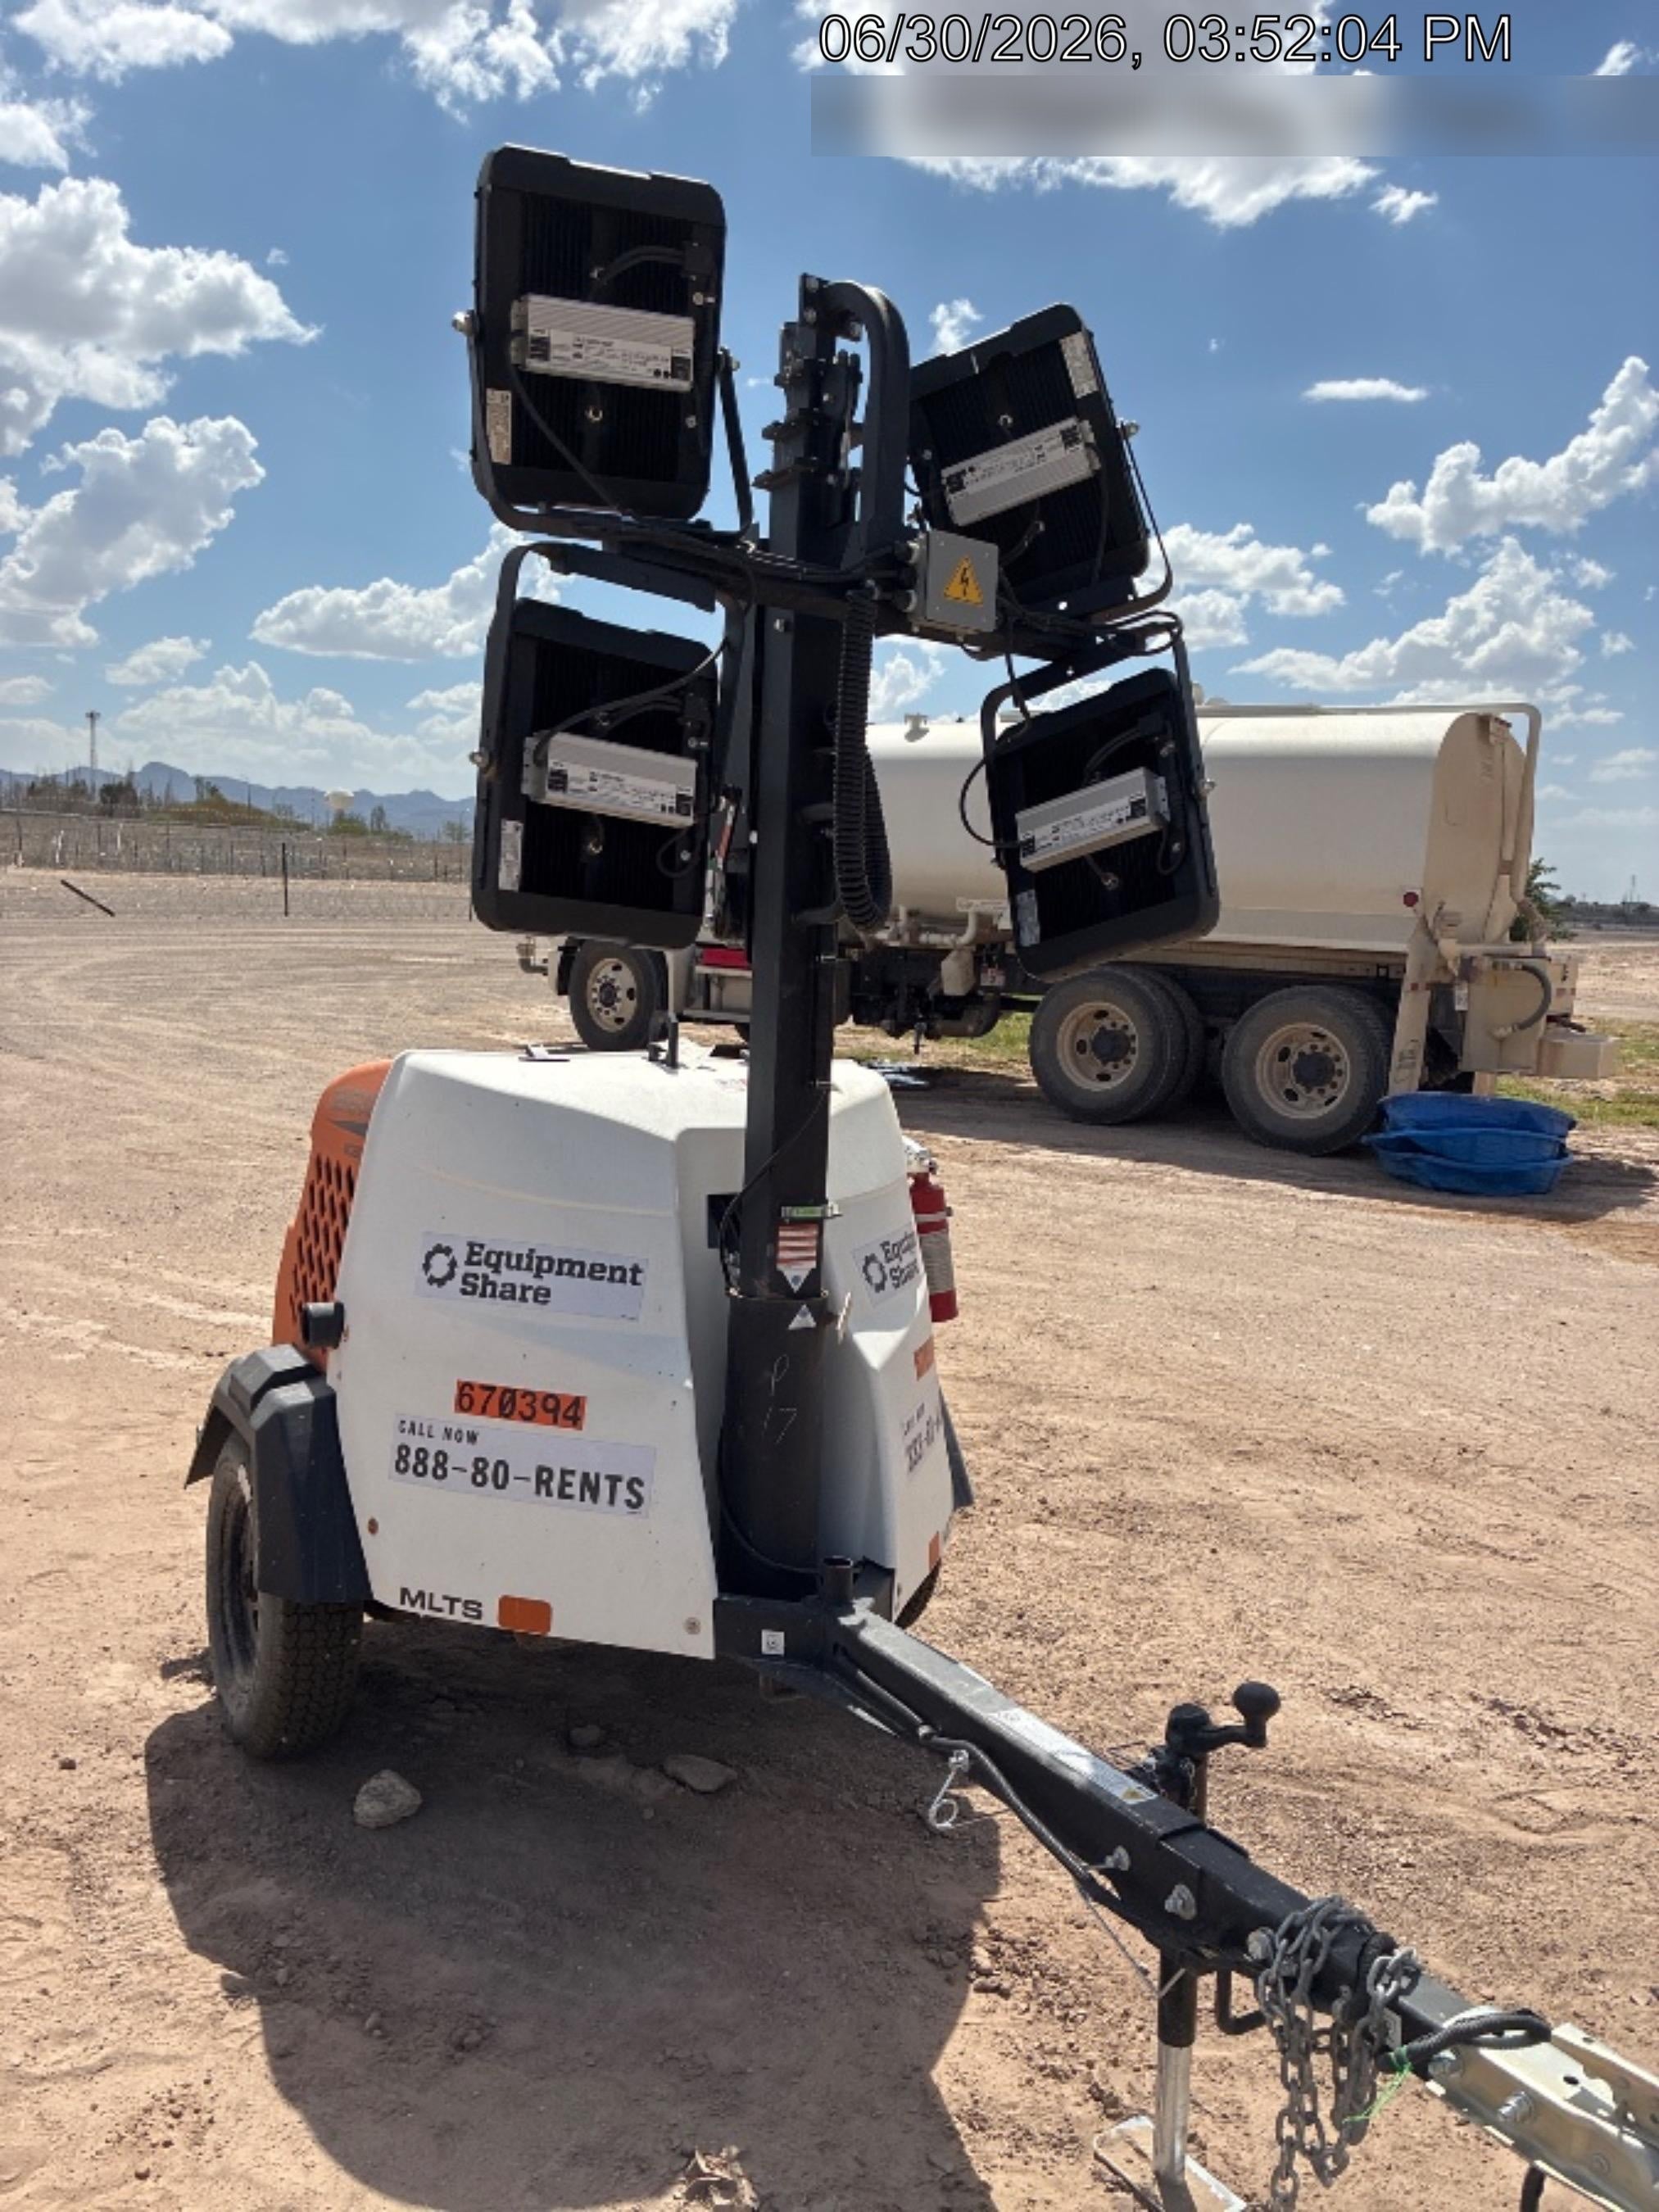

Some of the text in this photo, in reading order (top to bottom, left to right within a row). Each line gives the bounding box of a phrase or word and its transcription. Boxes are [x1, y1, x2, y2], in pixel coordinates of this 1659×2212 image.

[464, 1240, 645, 1286] Equipment
[459, 1271, 552, 1306] Share
[456, 1380, 583, 1428] 670394
[397, 1418, 479, 1445] CALL NOW
[394, 1443, 646, 1511] 888-80-RENTS
[399, 1586, 483, 1621] MLTS
